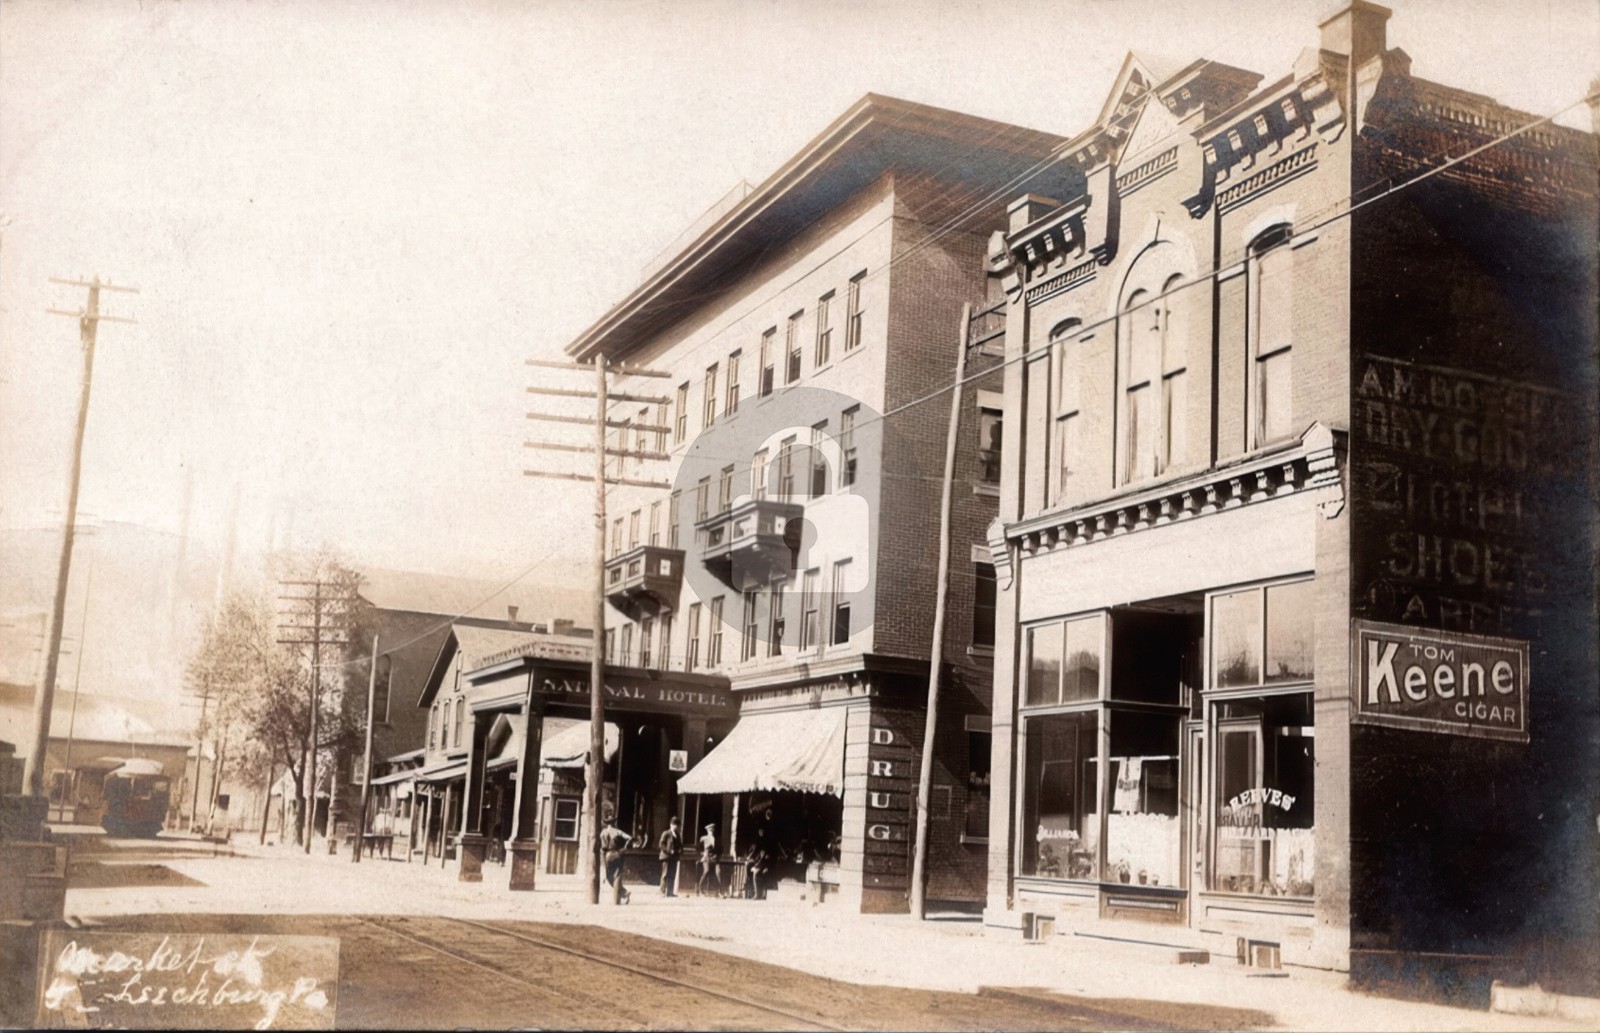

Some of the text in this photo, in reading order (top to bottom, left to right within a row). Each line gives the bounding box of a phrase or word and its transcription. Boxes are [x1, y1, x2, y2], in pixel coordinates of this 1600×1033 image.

[1409, 643, 1455, 662] TOM
[1366, 639, 1515, 705] Keene
[542, 678, 646, 699] NATINAL
[658, 688, 727, 707] HOTEL
[1454, 701, 1516, 723] CIGAR
